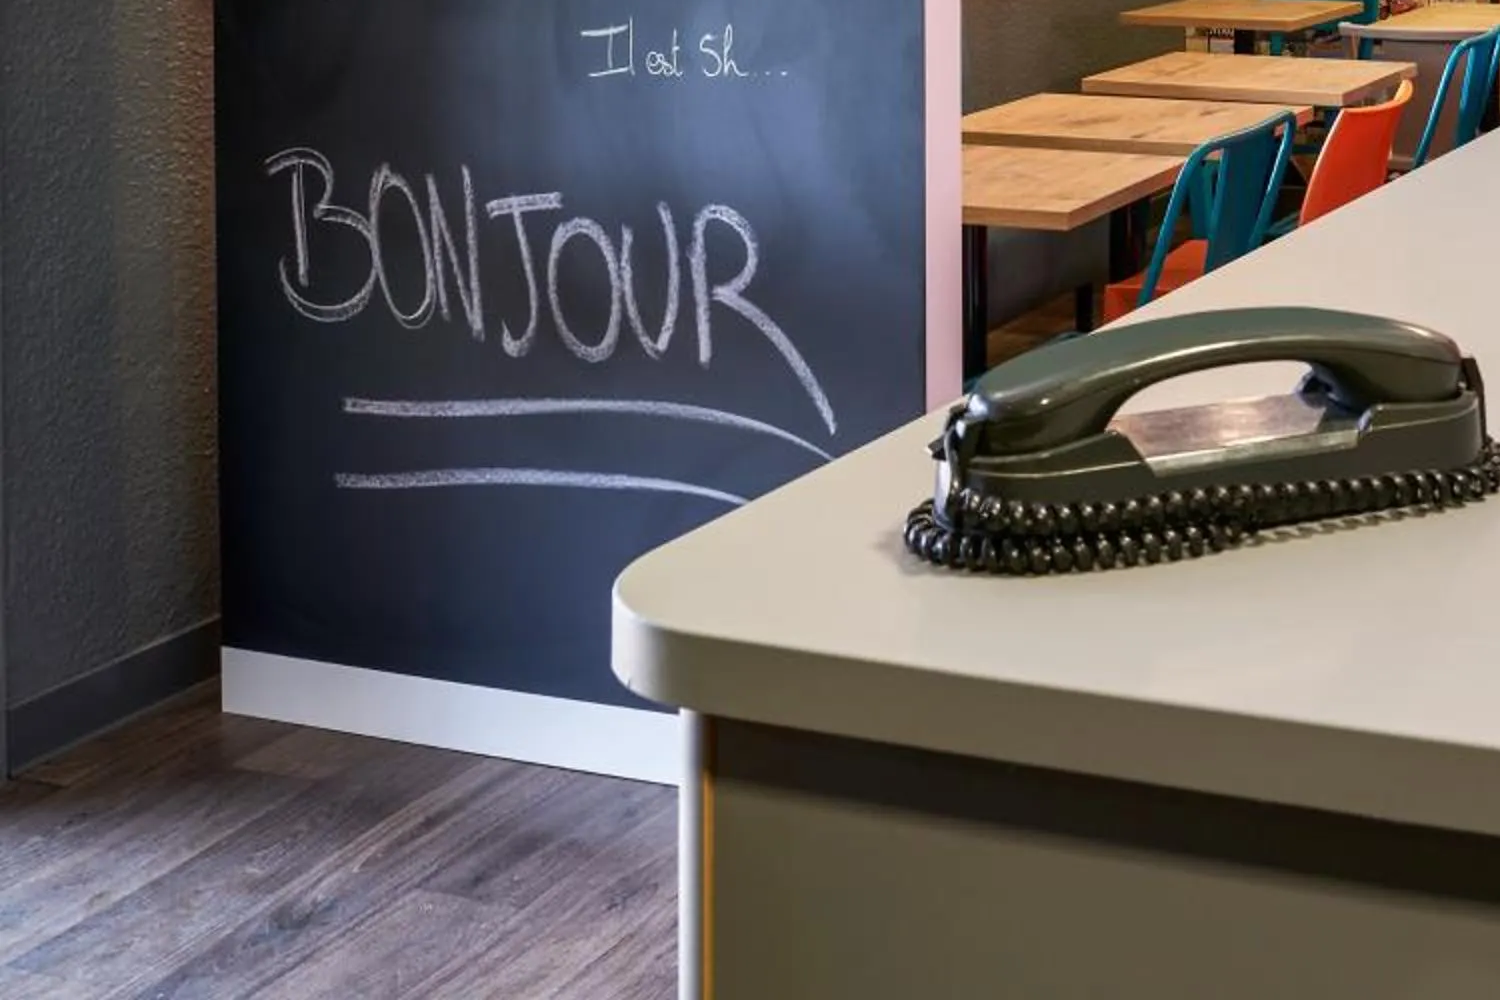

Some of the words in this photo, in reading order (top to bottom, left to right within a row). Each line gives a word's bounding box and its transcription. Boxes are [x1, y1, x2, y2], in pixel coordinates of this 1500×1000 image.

[579, 14, 637, 78] Il
[644, 28, 685, 78] est
[264, 146, 837, 436] BONJOUR
